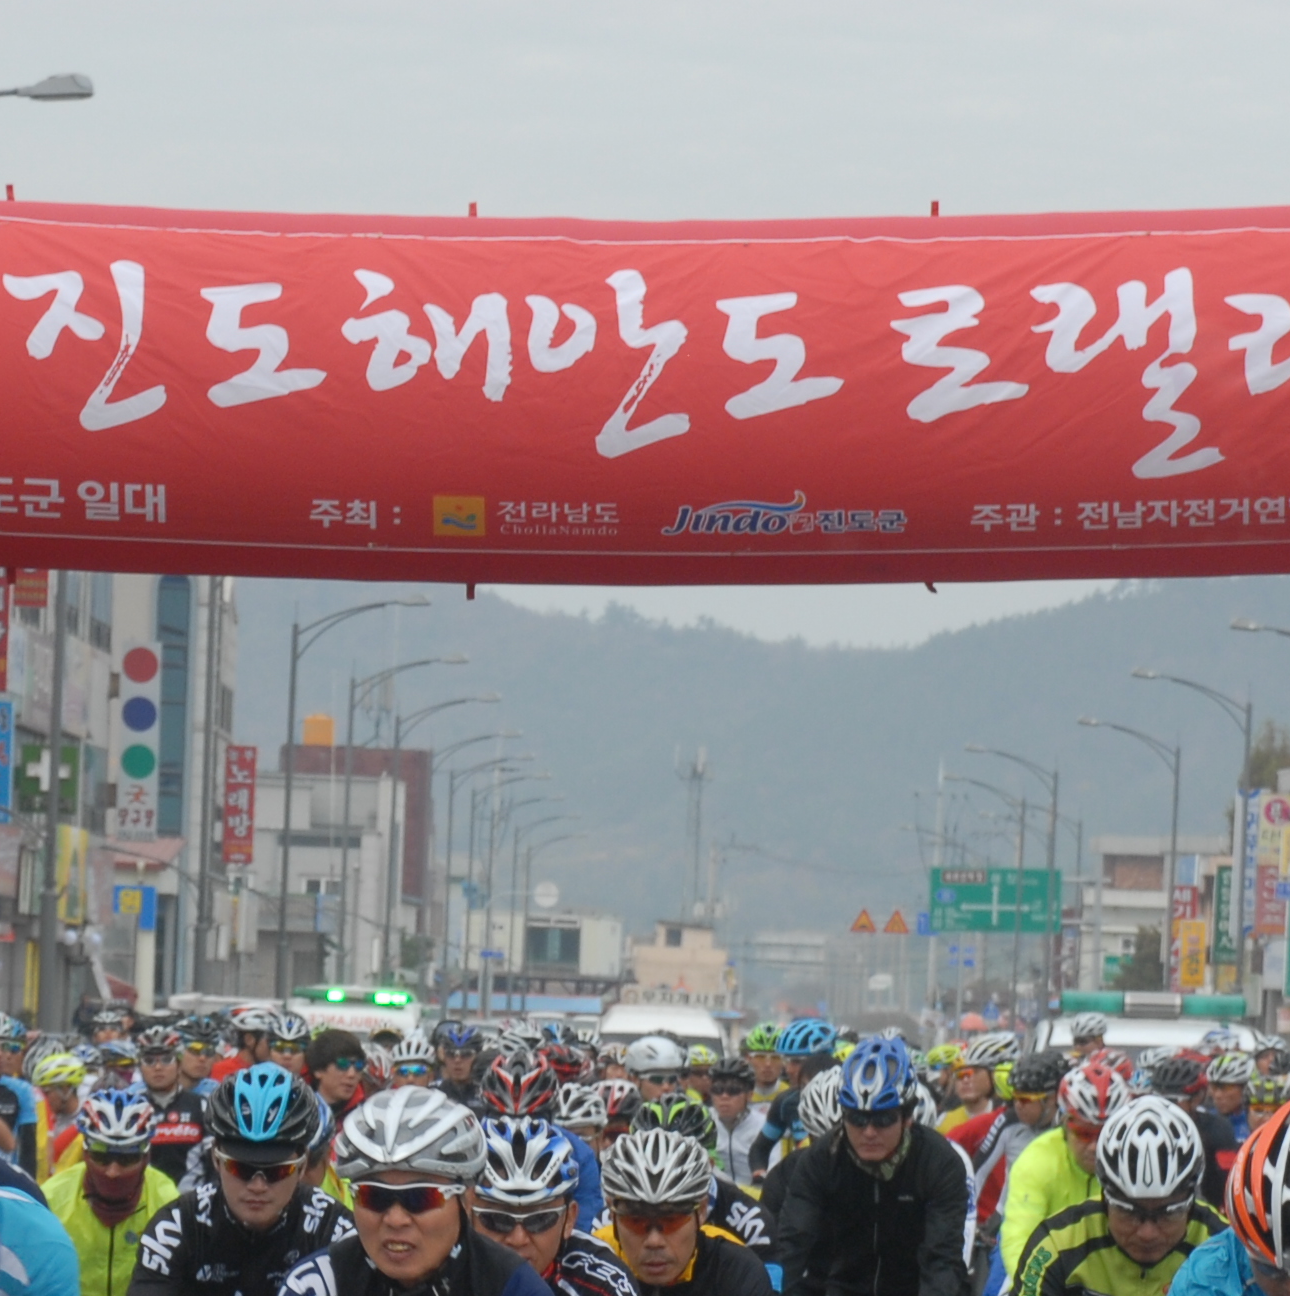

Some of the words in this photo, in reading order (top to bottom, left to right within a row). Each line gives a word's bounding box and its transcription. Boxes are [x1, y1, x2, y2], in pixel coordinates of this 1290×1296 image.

[76, 480, 167, 523] 일대
[308, 498, 379, 531] 주최
[496, 500, 620, 524] 전라남도
[815, 510, 908, 534] 진도군
[969, 503, 1040, 532] 주관
